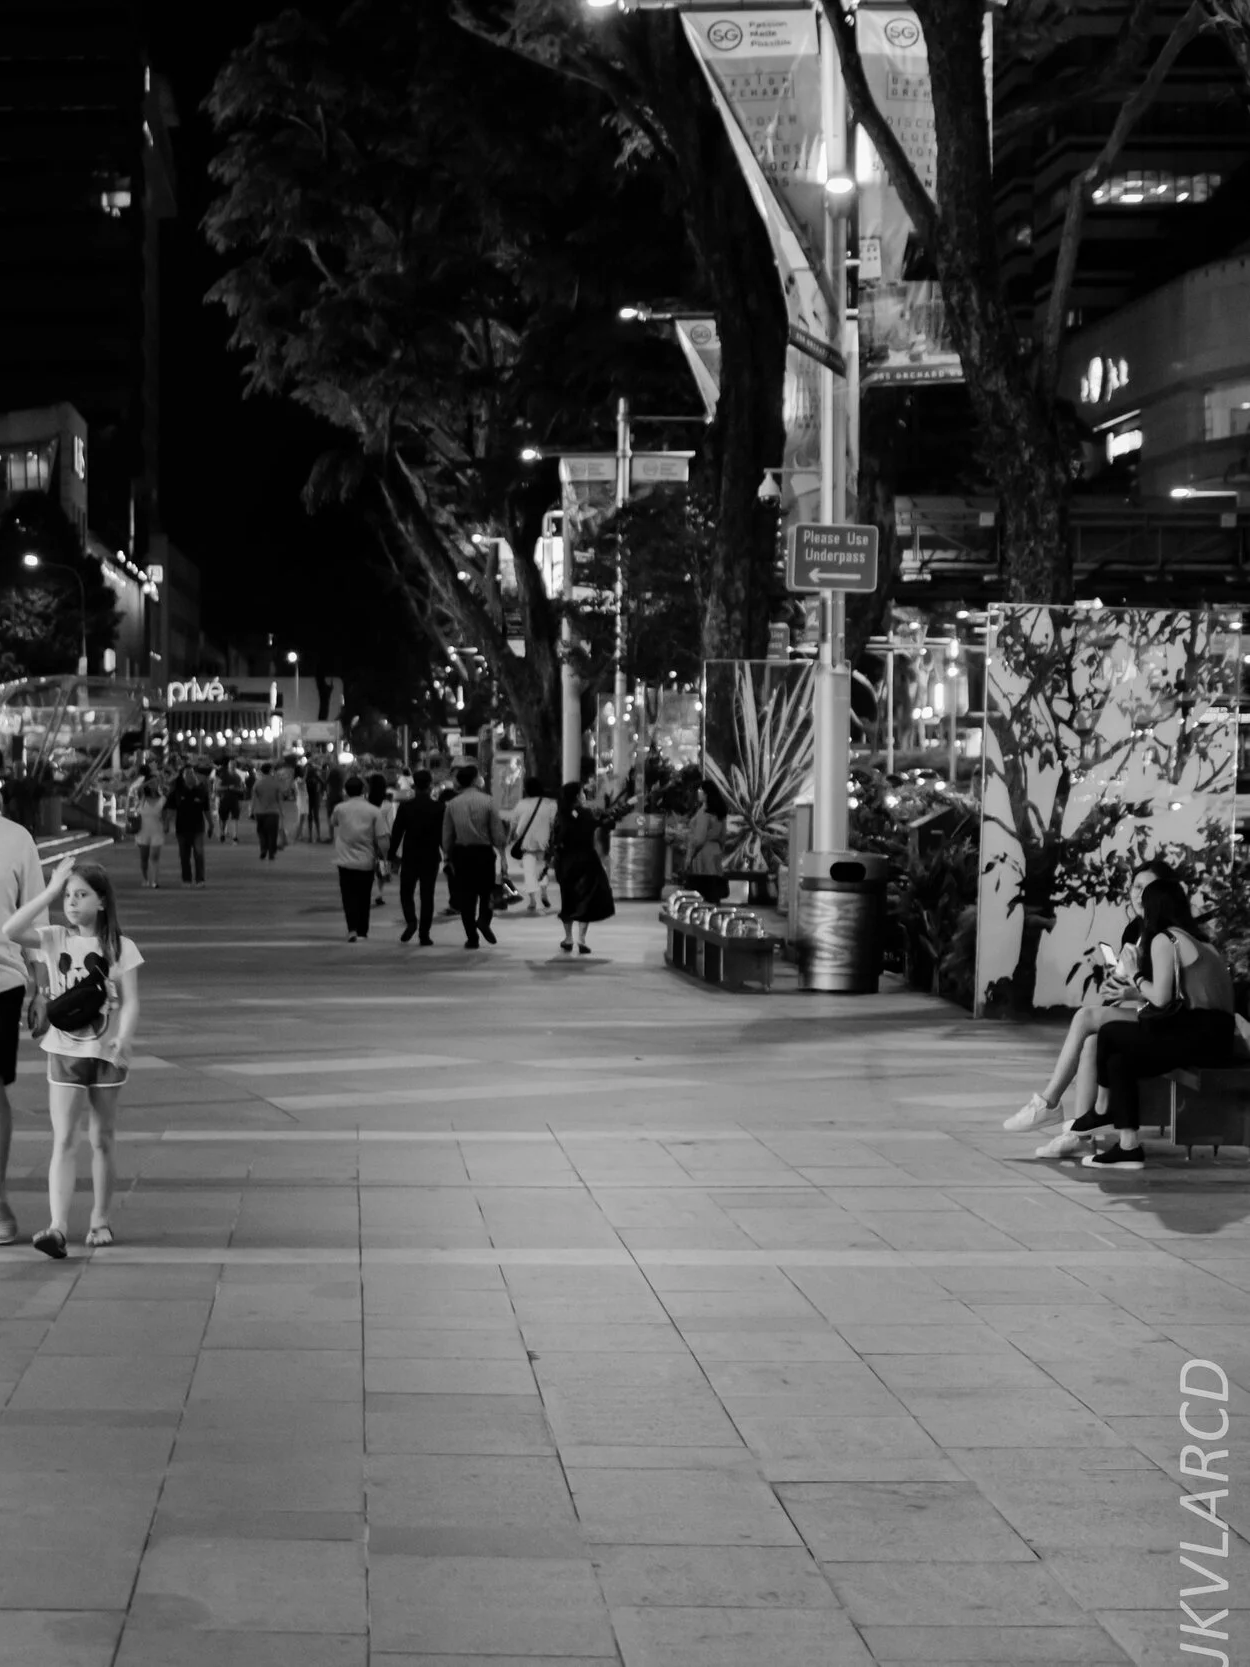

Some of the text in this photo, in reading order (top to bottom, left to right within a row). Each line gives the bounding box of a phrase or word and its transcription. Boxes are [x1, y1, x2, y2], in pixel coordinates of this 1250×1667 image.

[804, 529, 869, 546] Please Use
[805, 547, 866, 565] Underpass
